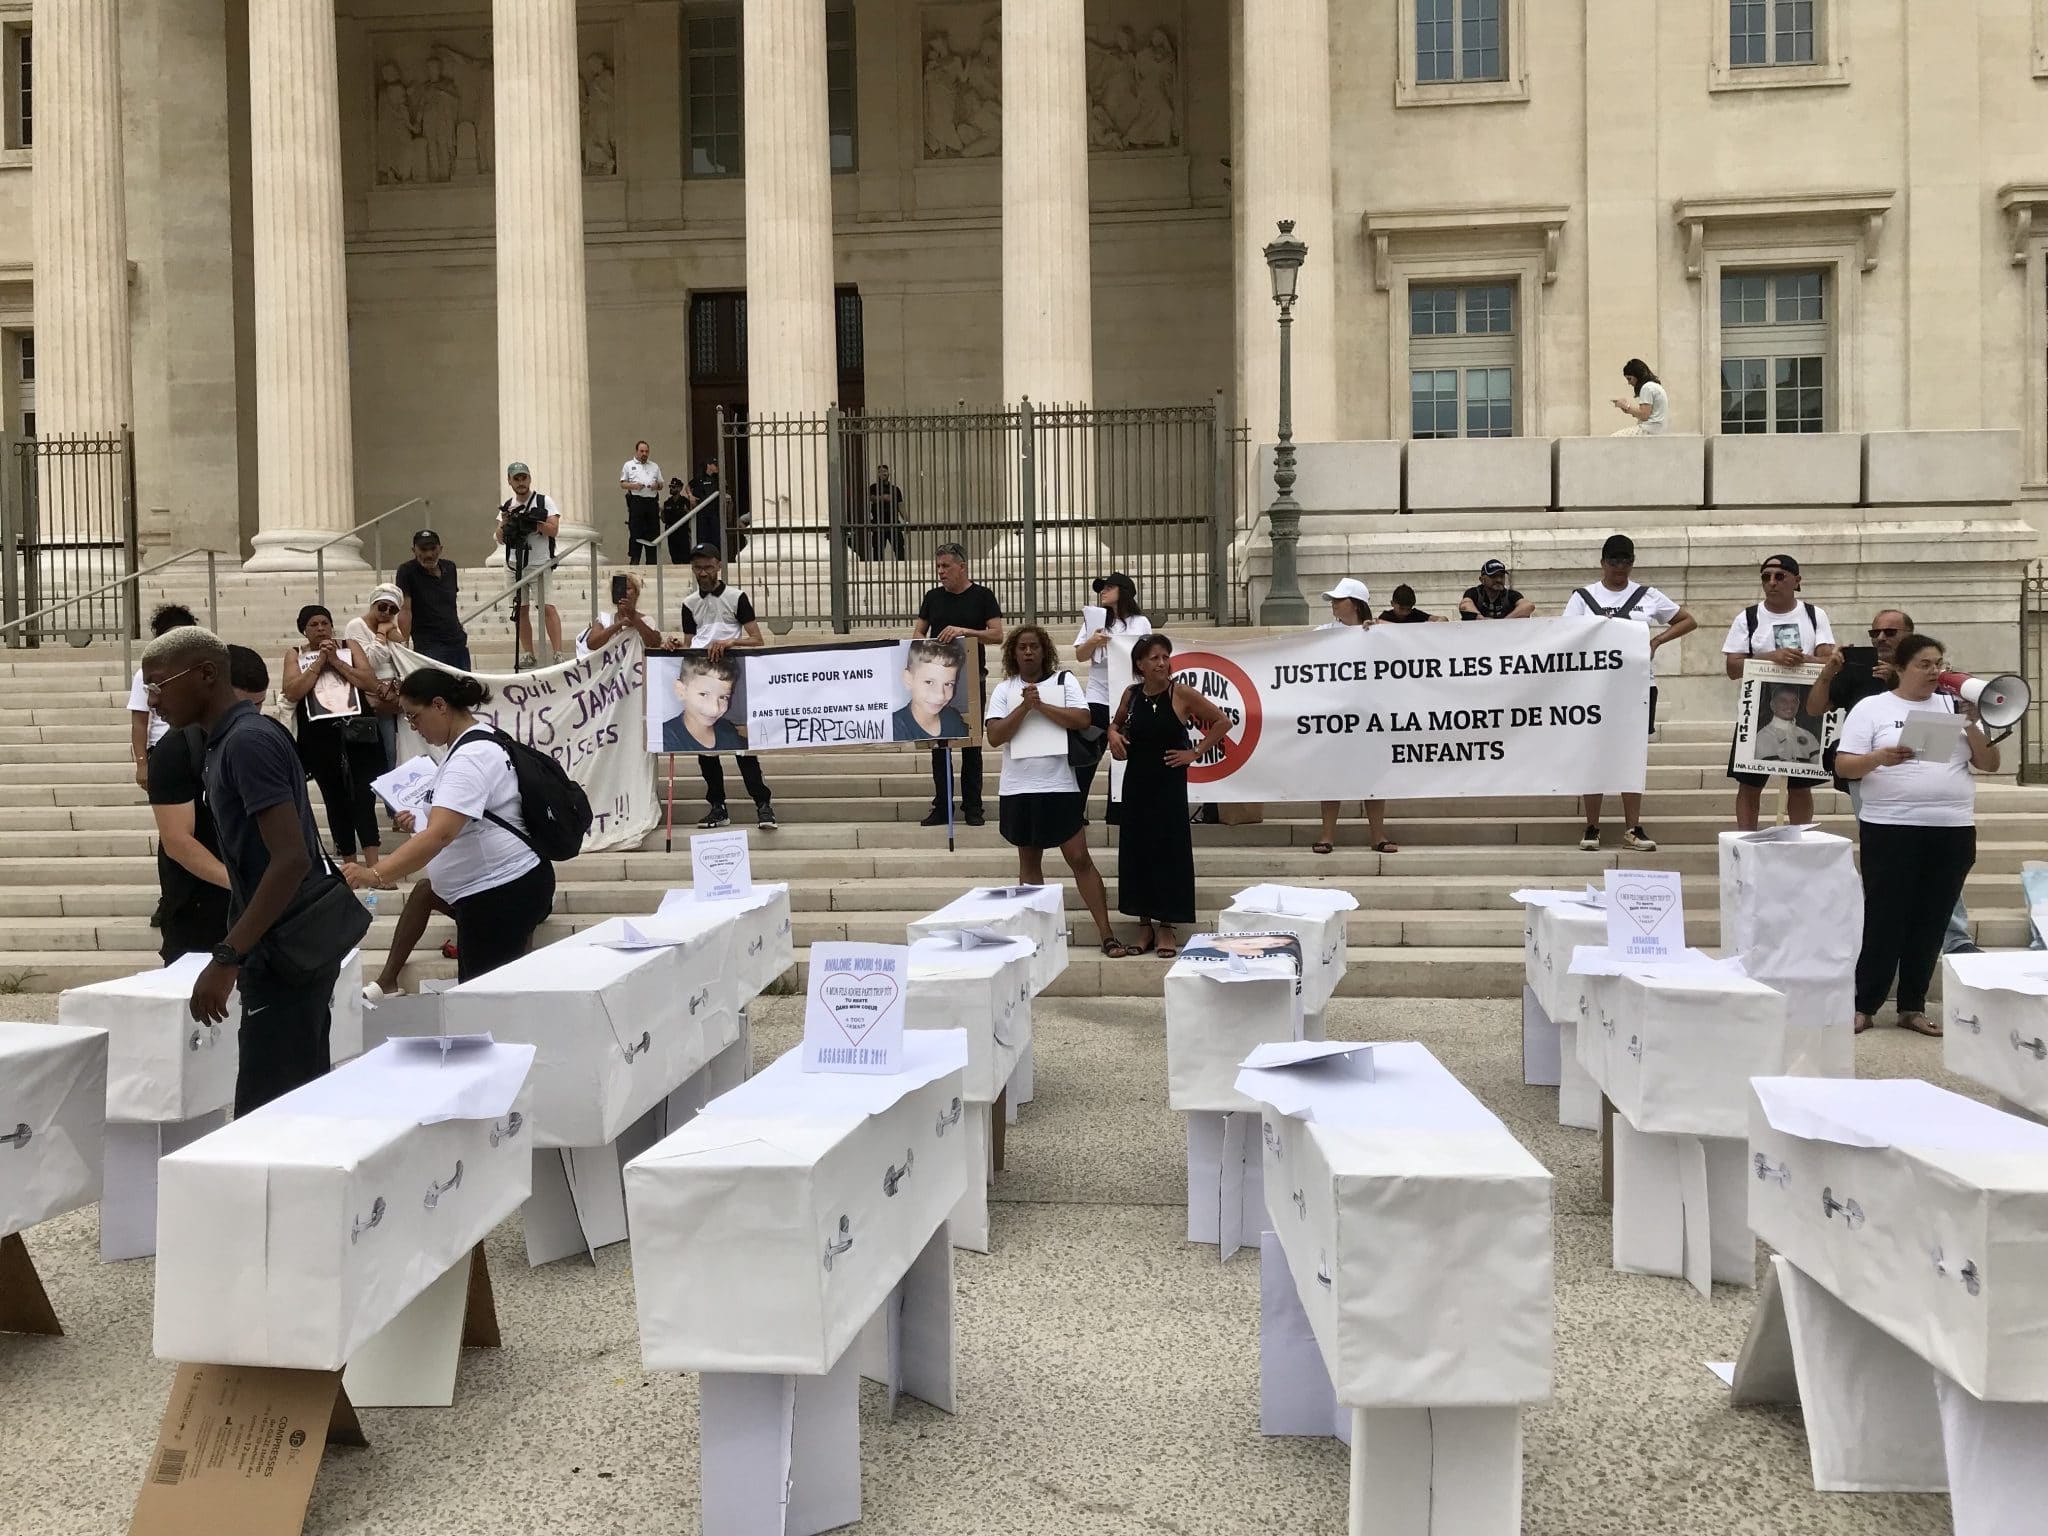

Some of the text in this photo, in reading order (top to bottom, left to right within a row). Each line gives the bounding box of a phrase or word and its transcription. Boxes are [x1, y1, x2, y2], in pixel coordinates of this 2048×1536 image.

[768, 669, 874, 685] JUSTICE POUR YANIS
[1270, 650, 1624, 690] JUSTICE POUR LES FAMILLES
[1202, 672, 1228, 700] AUX
[752, 710, 757, 718] 8
[758, 709, 773, 717] ANS
[791, 708, 800, 716] LE
[802, 706, 822, 715] 05.02
[824, 704, 853, 713] DEVANT
[854, 704, 865, 712] SA
[1296, 704, 1602, 734] STOP A LA MORT DE NOS
[784, 718, 885, 744] PERPIGNAN
[1392, 740, 1505, 764] ENFANTS
[264, 1416, 288, 1478] COMPRESSES
